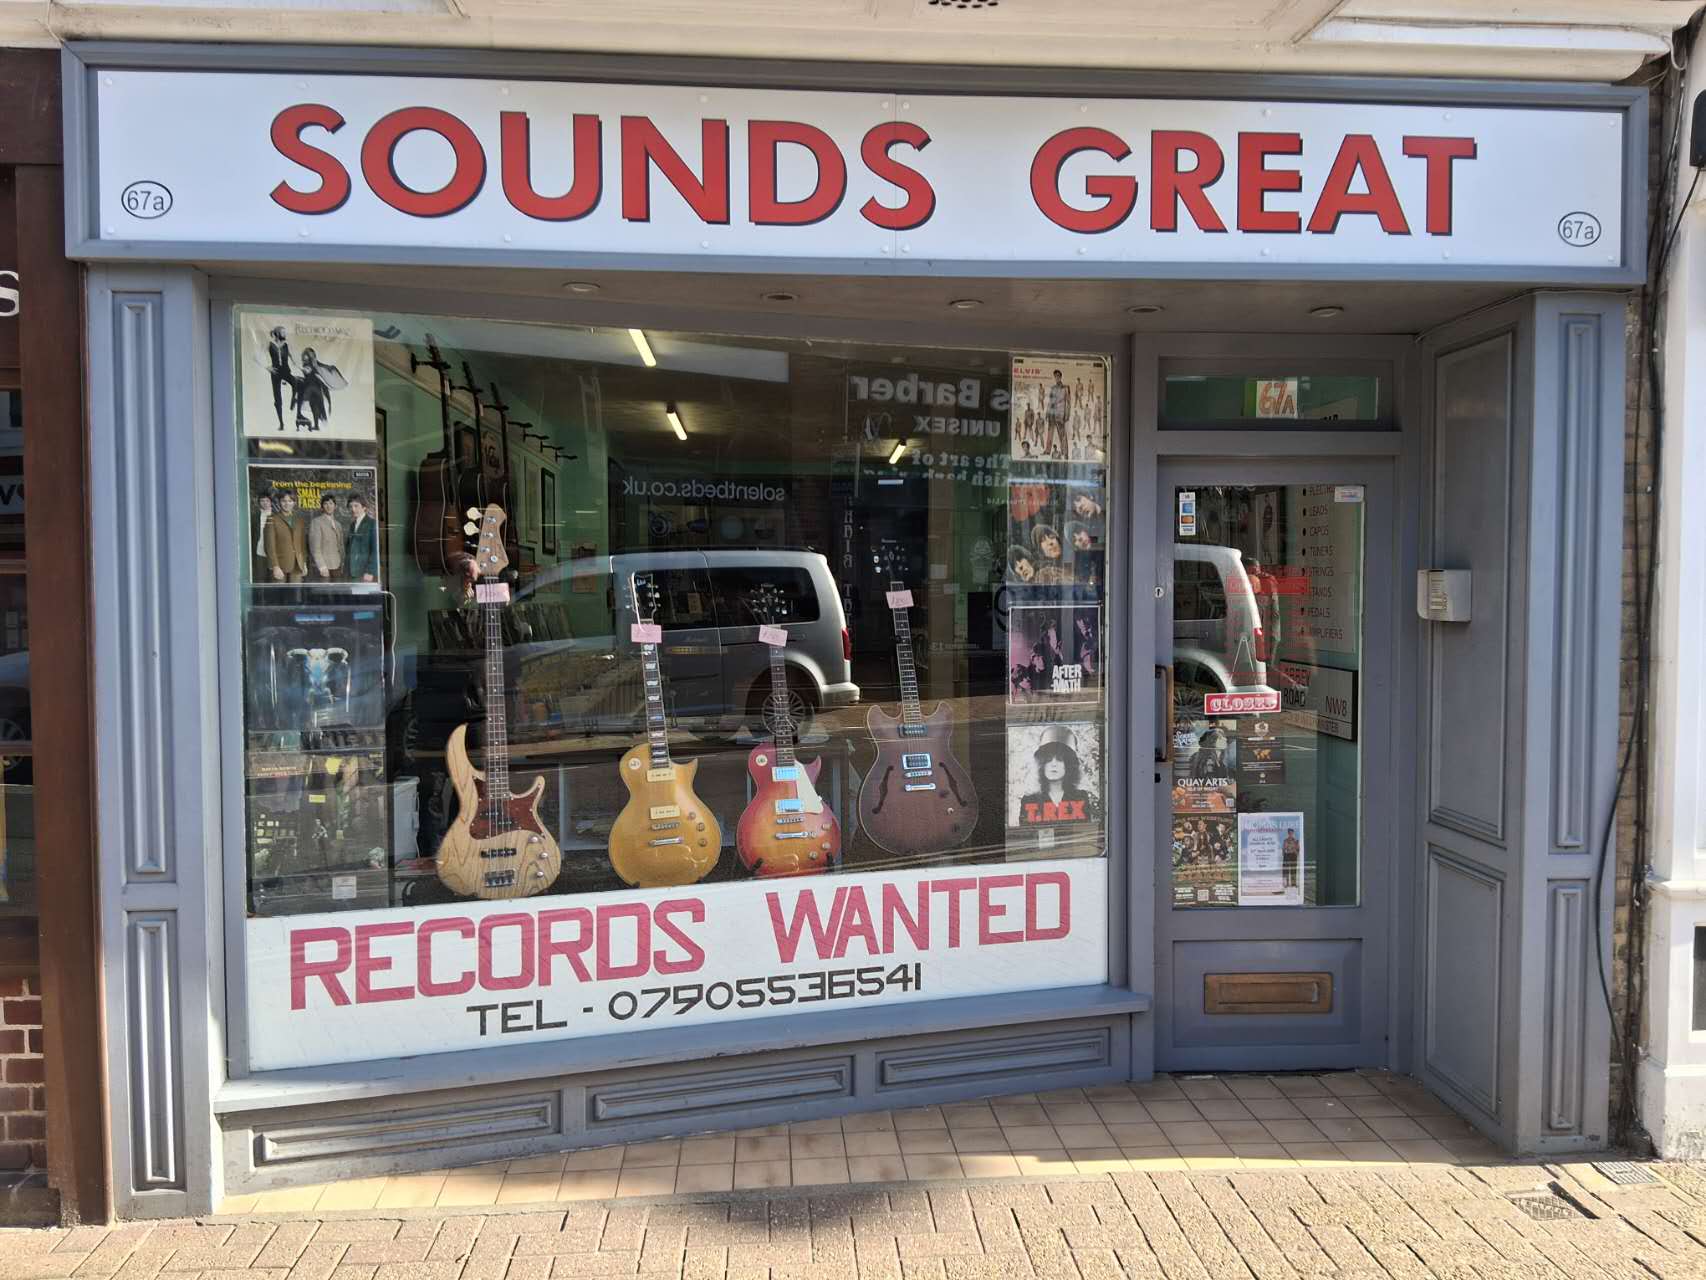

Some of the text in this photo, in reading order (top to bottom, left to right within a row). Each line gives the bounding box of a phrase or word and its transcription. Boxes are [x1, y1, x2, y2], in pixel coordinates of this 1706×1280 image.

[270, 103, 1477, 237] SOUNDS GREAT
[127, 190, 166, 212] 67a
[1562, 220, 1594, 241] 67a
[296, 488, 321, 498] SMALL
[297, 498, 321, 509] FACES
[1051, 664, 1082, 679] AFTER
[1210, 696, 1278, 712] CLOSED
[1283, 687, 1348, 717] ROAD NW8
[1177, 777, 1228, 788] QUAY ARTS
[1024, 800, 1088, 823] T.REX
[290, 871, 1072, 1011] RECORDS WANTED
[466, 999, 568, 1037] TEL
[608, 962, 922, 1021] 07905536541
